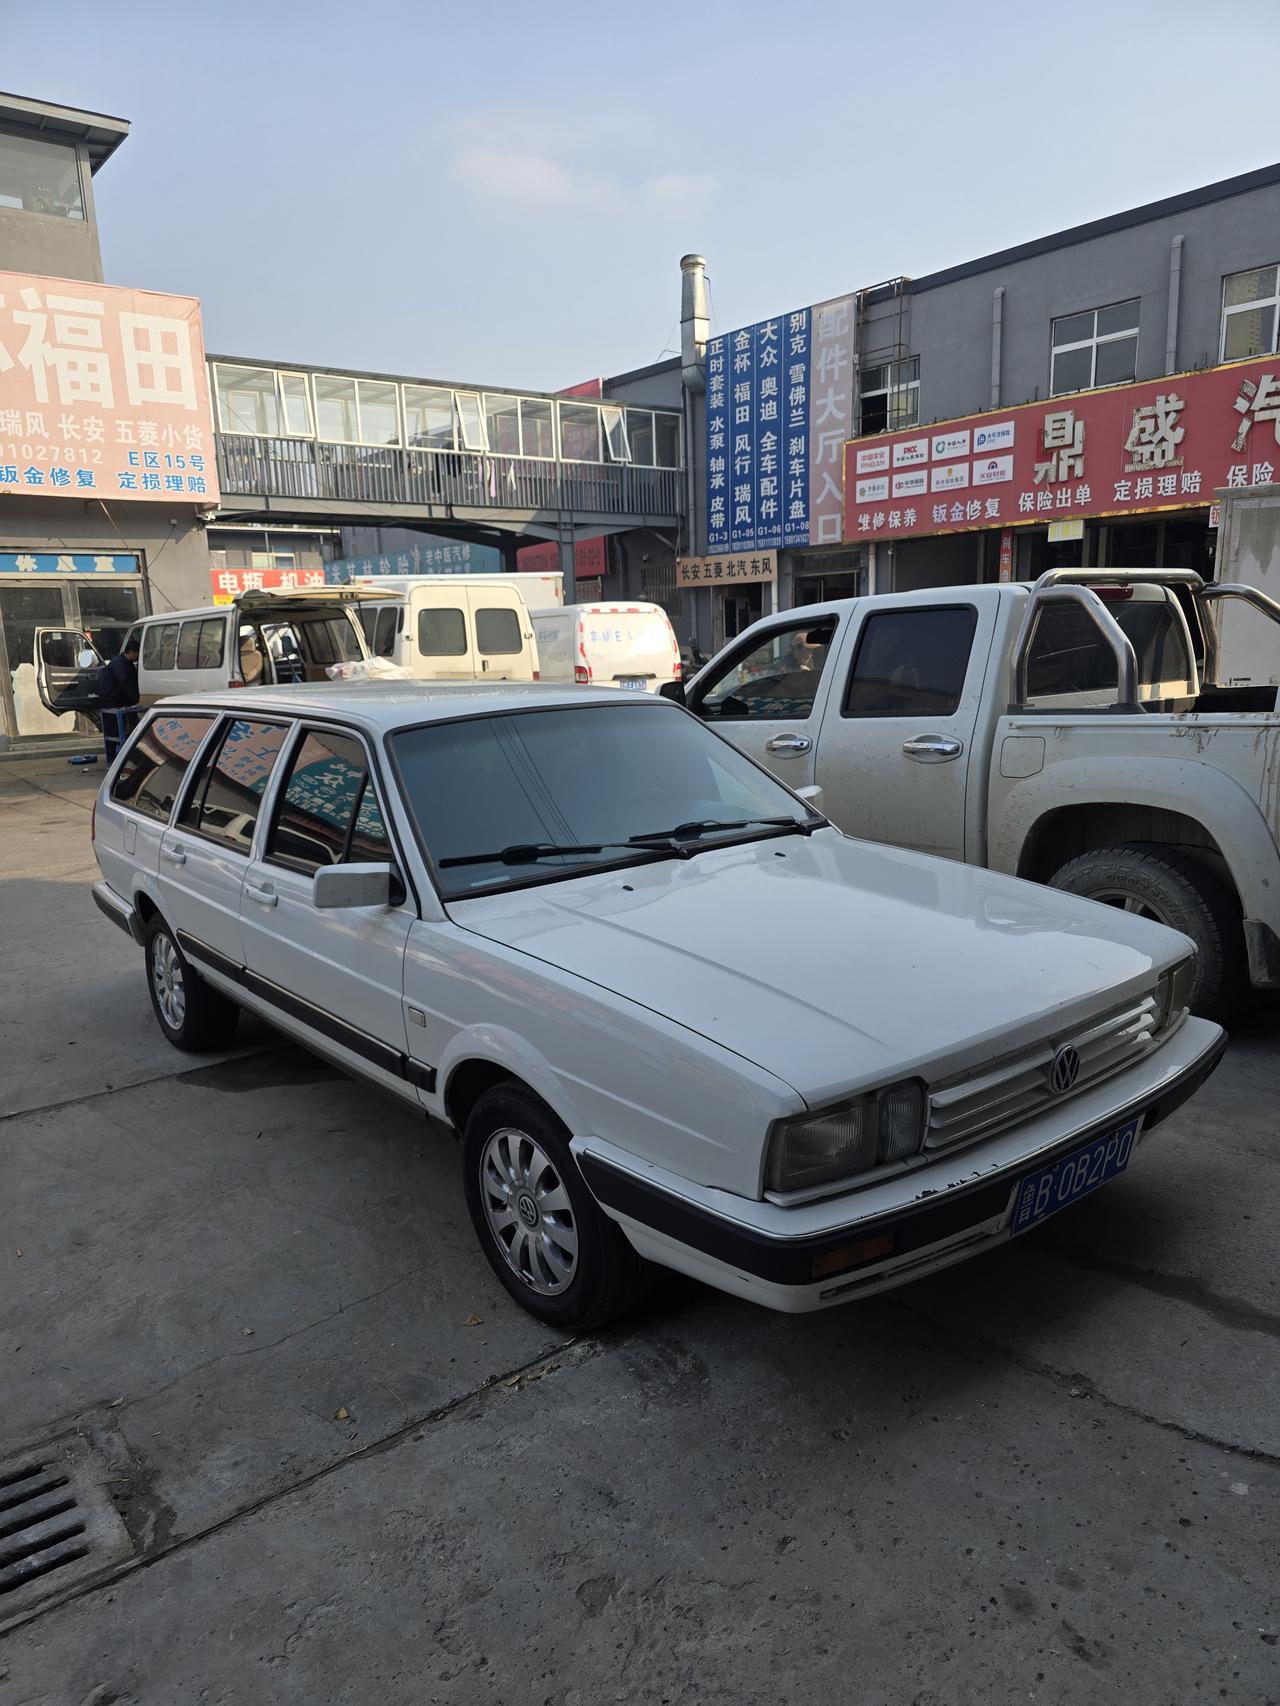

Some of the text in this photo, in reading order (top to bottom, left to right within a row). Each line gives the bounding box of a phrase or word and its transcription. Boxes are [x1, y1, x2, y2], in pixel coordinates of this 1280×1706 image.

[0, 287, 198, 411] 福田
[733, 330, 751, 375] 金杯
[709, 338, 725, 409] 正时套装
[734, 381, 751, 424] 福田
[759, 321, 778, 519] 大众 奥迪 全车配件
[789, 310, 807, 520] 别克 雪佛兰 刹车片盘
[0, 410, 204, 451] 瑞风 长安 五菱小货
[709, 415, 725, 450] 水泵
[815, 307, 849, 544] 配件大厅入口
[128, 451, 205, 473] E区15号
[734, 434, 752, 476] 风行
[903, 445, 918, 455] PICC
[0, 465, 207, 494] 钣金修复 定损理赔
[709, 456, 725, 490] 轴承
[709, 496, 725, 529] 皮带
[734, 484, 752, 525] 瑞风
[858, 461, 1275, 532] 维修保养 钣金修复 保险出单 定损理赔 保险
[708, 531, 728, 543] G1-3
[731, 528, 755, 539] G1-05
[757, 524, 781, 536] G1-06
[218, 571, 264, 595] 电瓶
[681, 557, 772, 580] 长安 五菱 北汽 东风
